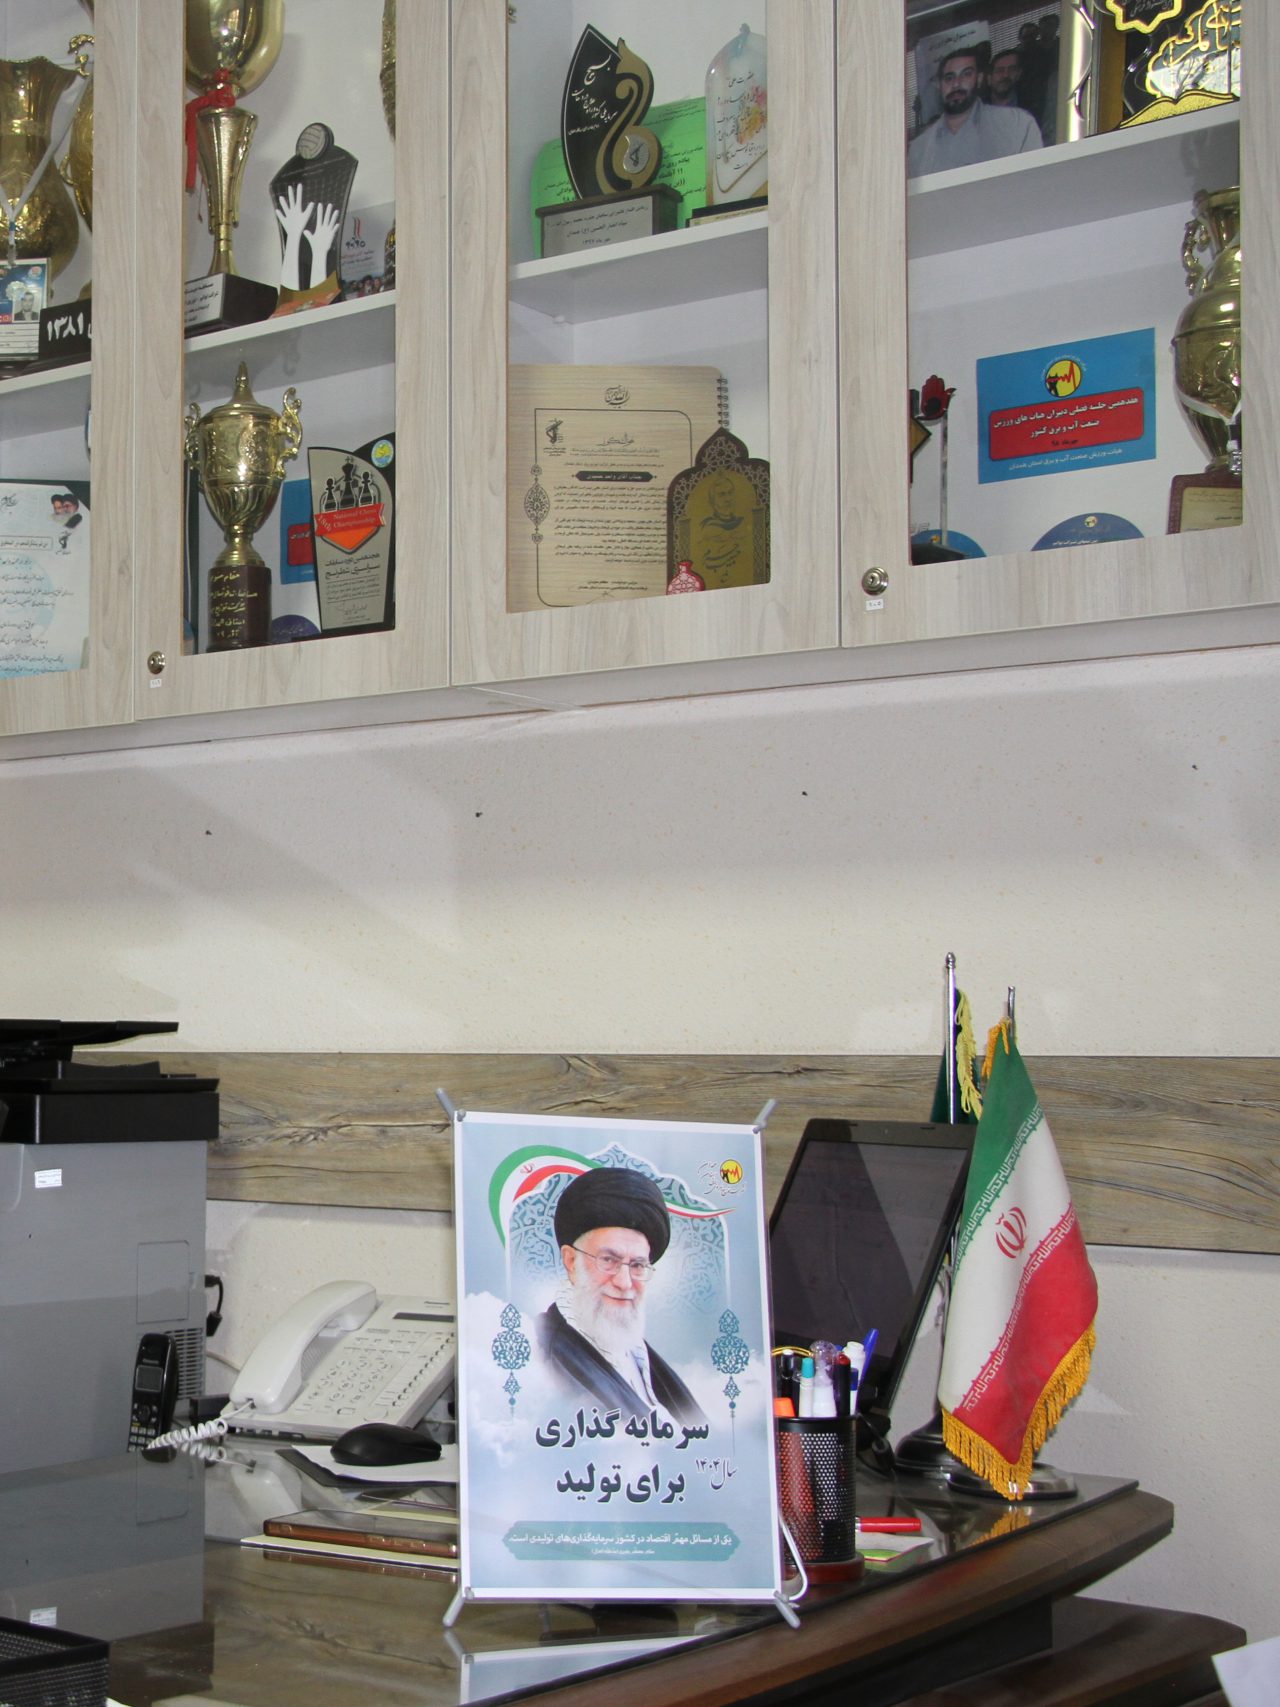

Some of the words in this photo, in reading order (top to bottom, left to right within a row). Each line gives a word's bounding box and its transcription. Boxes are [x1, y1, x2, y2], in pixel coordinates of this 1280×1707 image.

[1067, 419, 1079, 430] آب
[1080, 420, 1100, 428] صنعت
[1030, 426, 1047, 438] کشور
[1049, 426, 1061, 435] برق
[535, 1406, 620, 1448] گذاری
[624, 1408, 710, 1449] سرمایه
[695, 1458, 720, 1472] ۱۴۰۴
[710, 1458, 738, 1490] سال
[556, 1462, 622, 1503] تولید
[626, 1463, 685, 1503] برای
[529, 1533, 554, 1545] تولیدی
[615, 1534, 636, 1545] کشور
[636, 1535, 645, 1545] در
[646, 1533, 671, 1543] اقتصاد
[689, 1533, 713, 1545] مسائل
[713, 1534, 720, 1545] از
[720, 1534, 732, 1545] یکی
